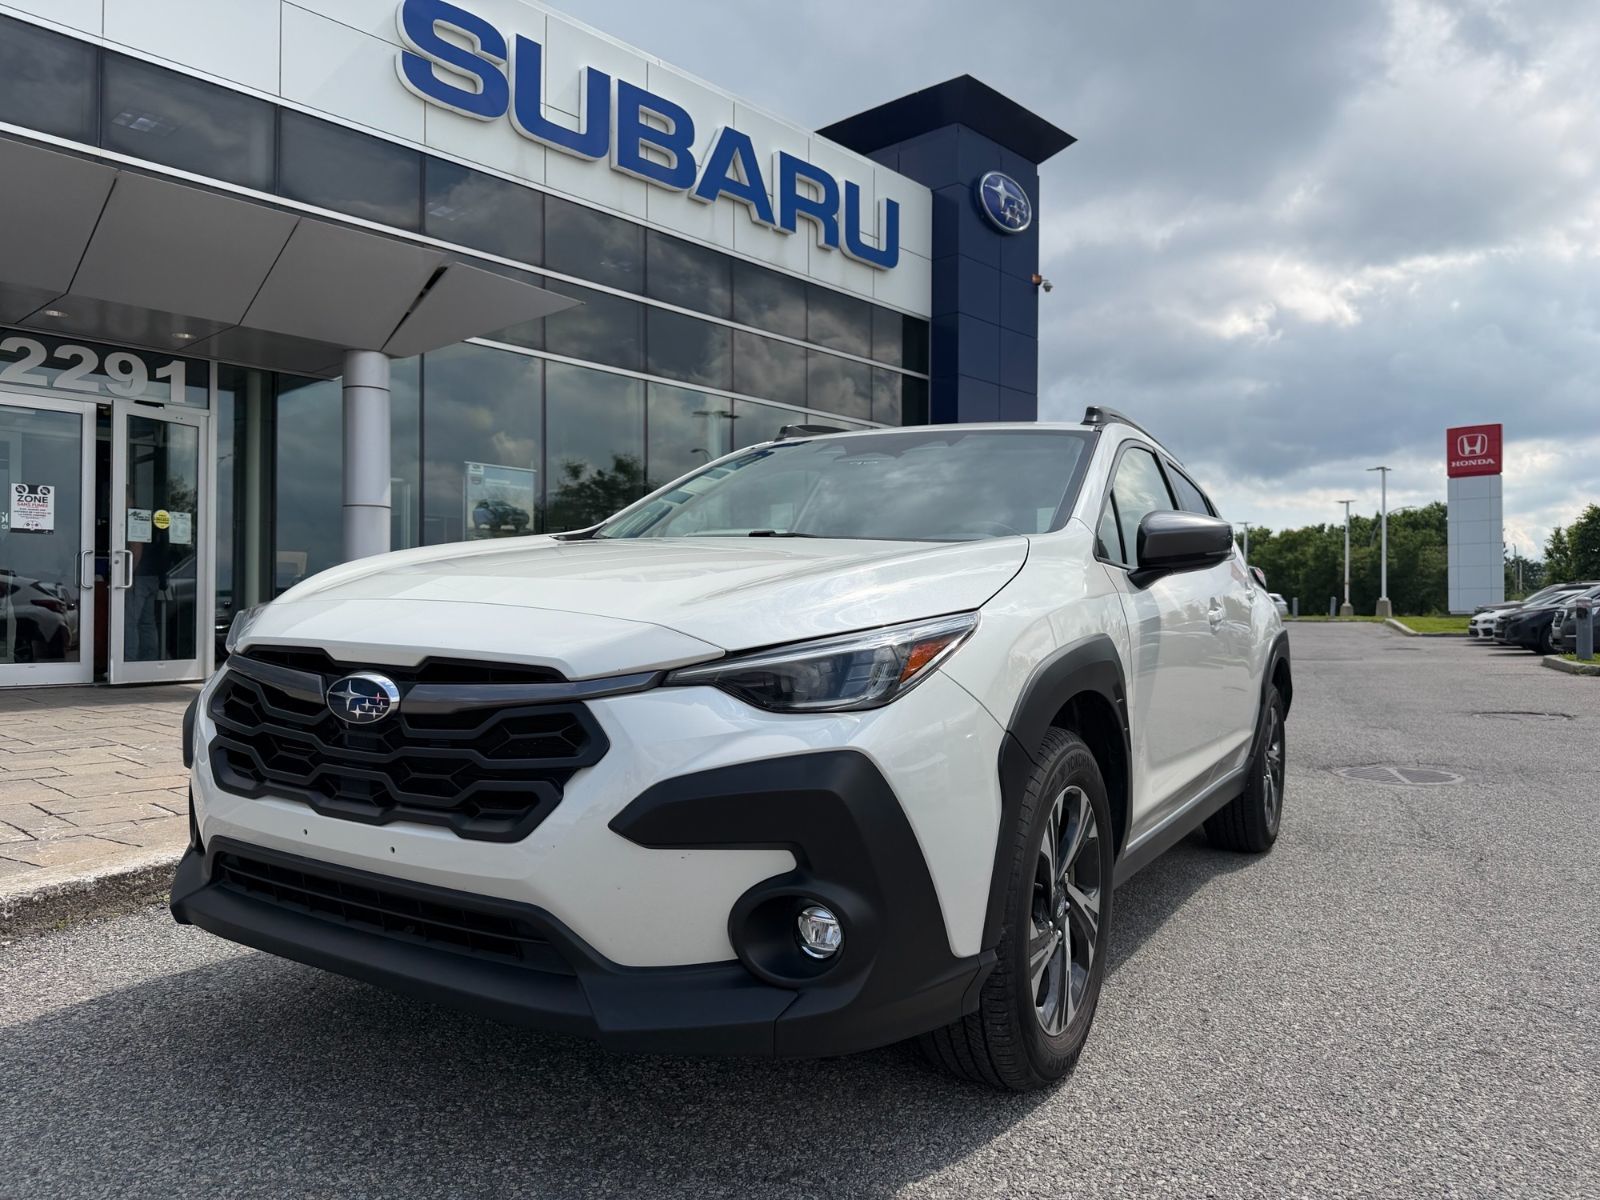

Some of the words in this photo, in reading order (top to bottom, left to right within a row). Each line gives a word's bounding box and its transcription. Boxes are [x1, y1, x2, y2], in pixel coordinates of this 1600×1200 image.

[397, 0, 900, 270] SUBARU
[0, 336, 186, 403] 2291
[1451, 458, 1496, 467] HONDA
[17, 494, 48, 504] ZONE
